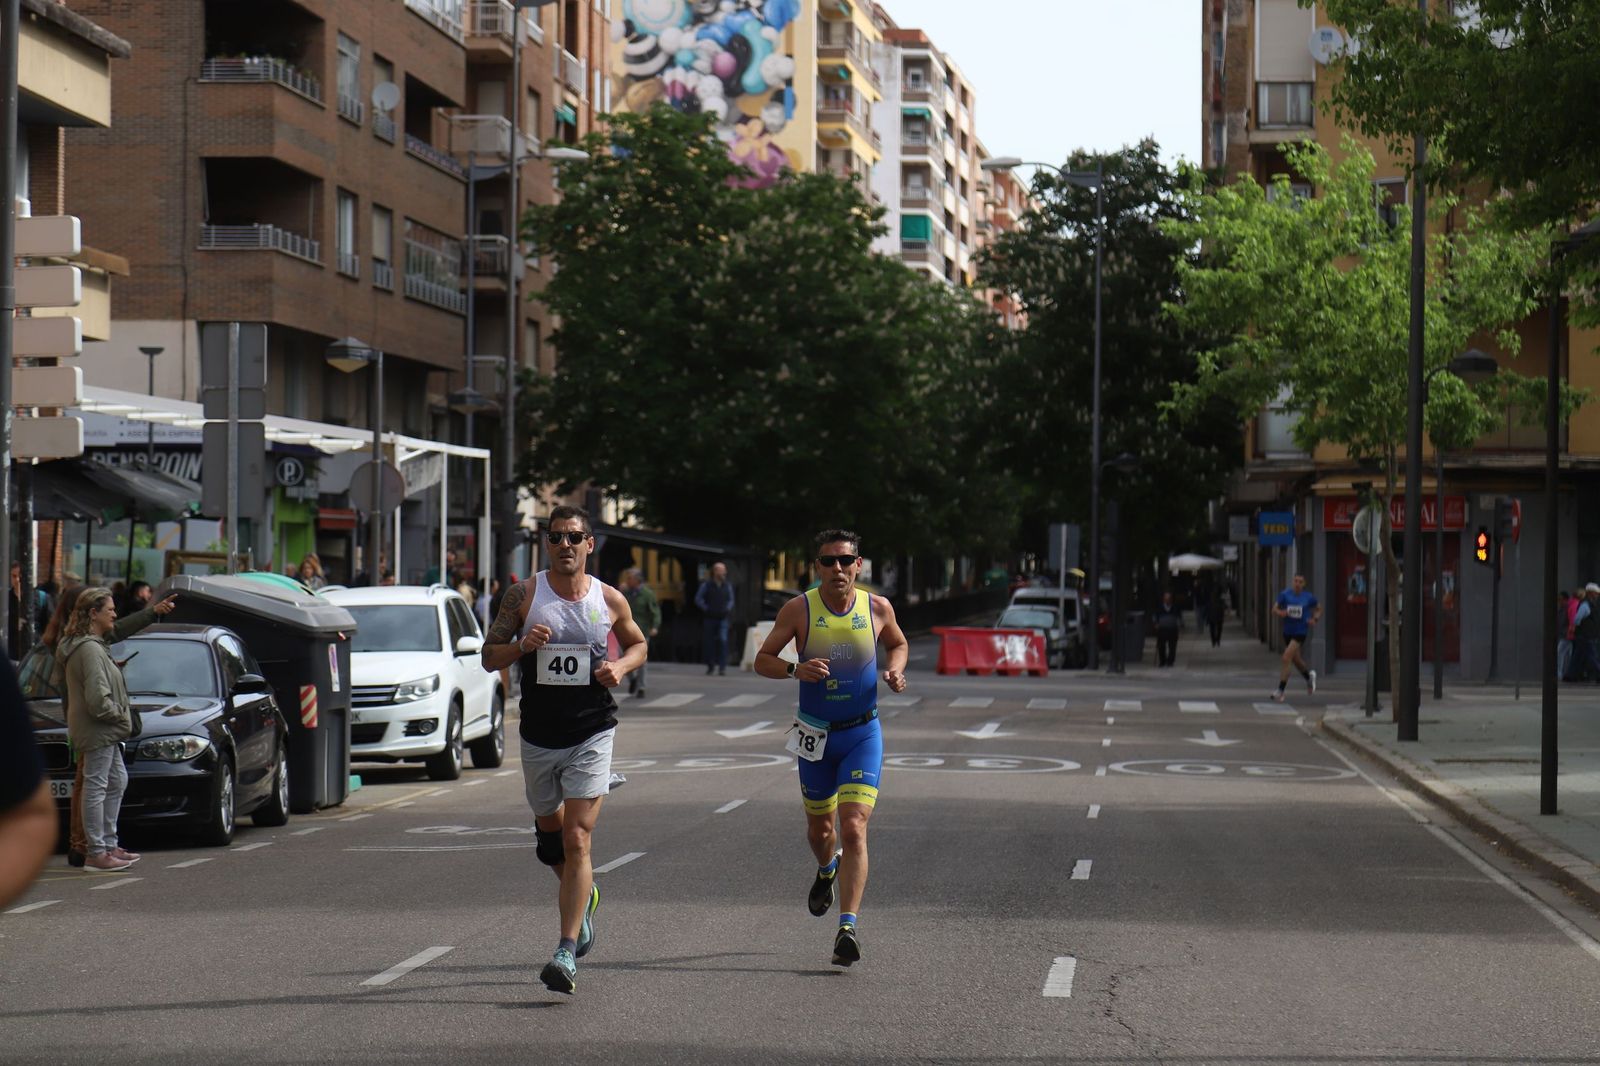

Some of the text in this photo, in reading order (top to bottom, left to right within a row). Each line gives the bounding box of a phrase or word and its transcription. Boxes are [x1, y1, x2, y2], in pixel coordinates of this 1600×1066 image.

[830, 643, 853, 660] GATO
[548, 656, 578, 675] 40
[798, 730, 816, 753] 78
[51, 782, 75, 796] 86
